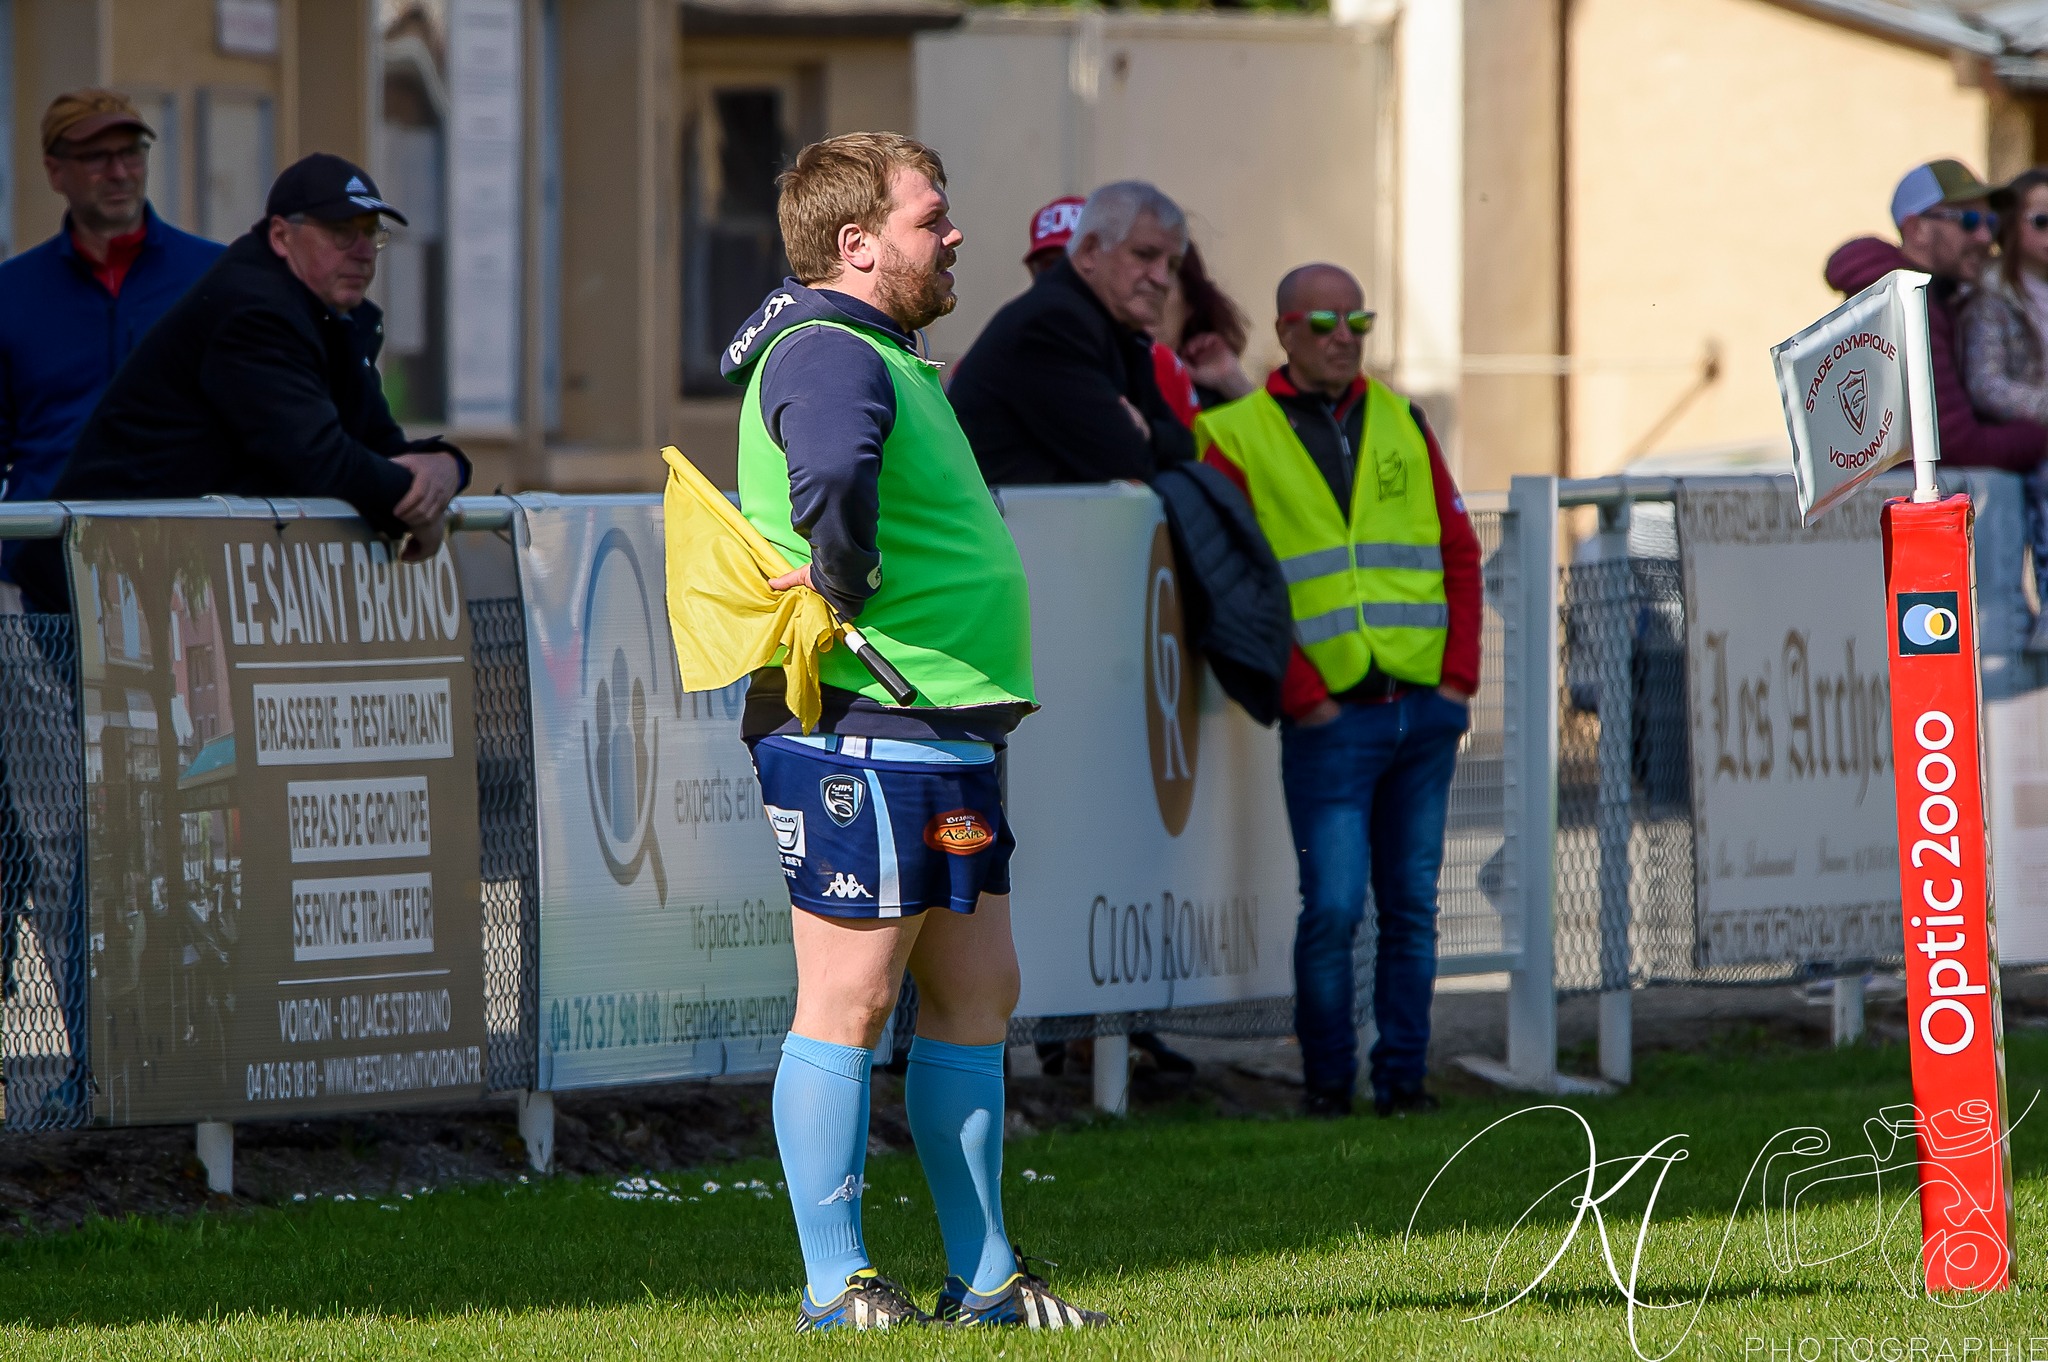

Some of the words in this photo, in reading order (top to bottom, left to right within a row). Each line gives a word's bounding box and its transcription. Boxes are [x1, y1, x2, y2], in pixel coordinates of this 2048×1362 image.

[1805, 354, 1834, 413] STADE
[1833, 333, 1897, 361] OLYMPIQUE
[1828, 408, 1894, 469] VOIRONNAIS
[224, 542, 265, 645] LE
[262, 541, 348, 646] SAINT
[352, 541, 461, 643] BRUNO
[257, 696, 341, 751] BRASSERIE
[350, 692, 448, 748] RESTAURANT
[290, 793, 338, 848] REPAS
[341, 793, 363, 846] DE
[365, 790, 429, 845] GROUPE
[674, 769, 732, 840] experts
[736, 776, 756, 820] en
[293, 890, 358, 948] SERVICE
[359, 886, 433, 943] TRAITEUR
[708, 899, 740, 962] place
[743, 898, 756, 947] St
[1910, 878, 1987, 1055] Optic
[278, 997, 333, 1043] VOIRON
[350, 992, 390, 1039] PLACE
[390, 991, 405, 1037] ST
[407, 988, 452, 1035] BRUNO
[551, 998, 570, 1051] 04
[574, 995, 593, 1050] 76
[597, 993, 616, 1049] 37
[247, 1063, 261, 1101] 04
[263, 1062, 276, 1100] 76
